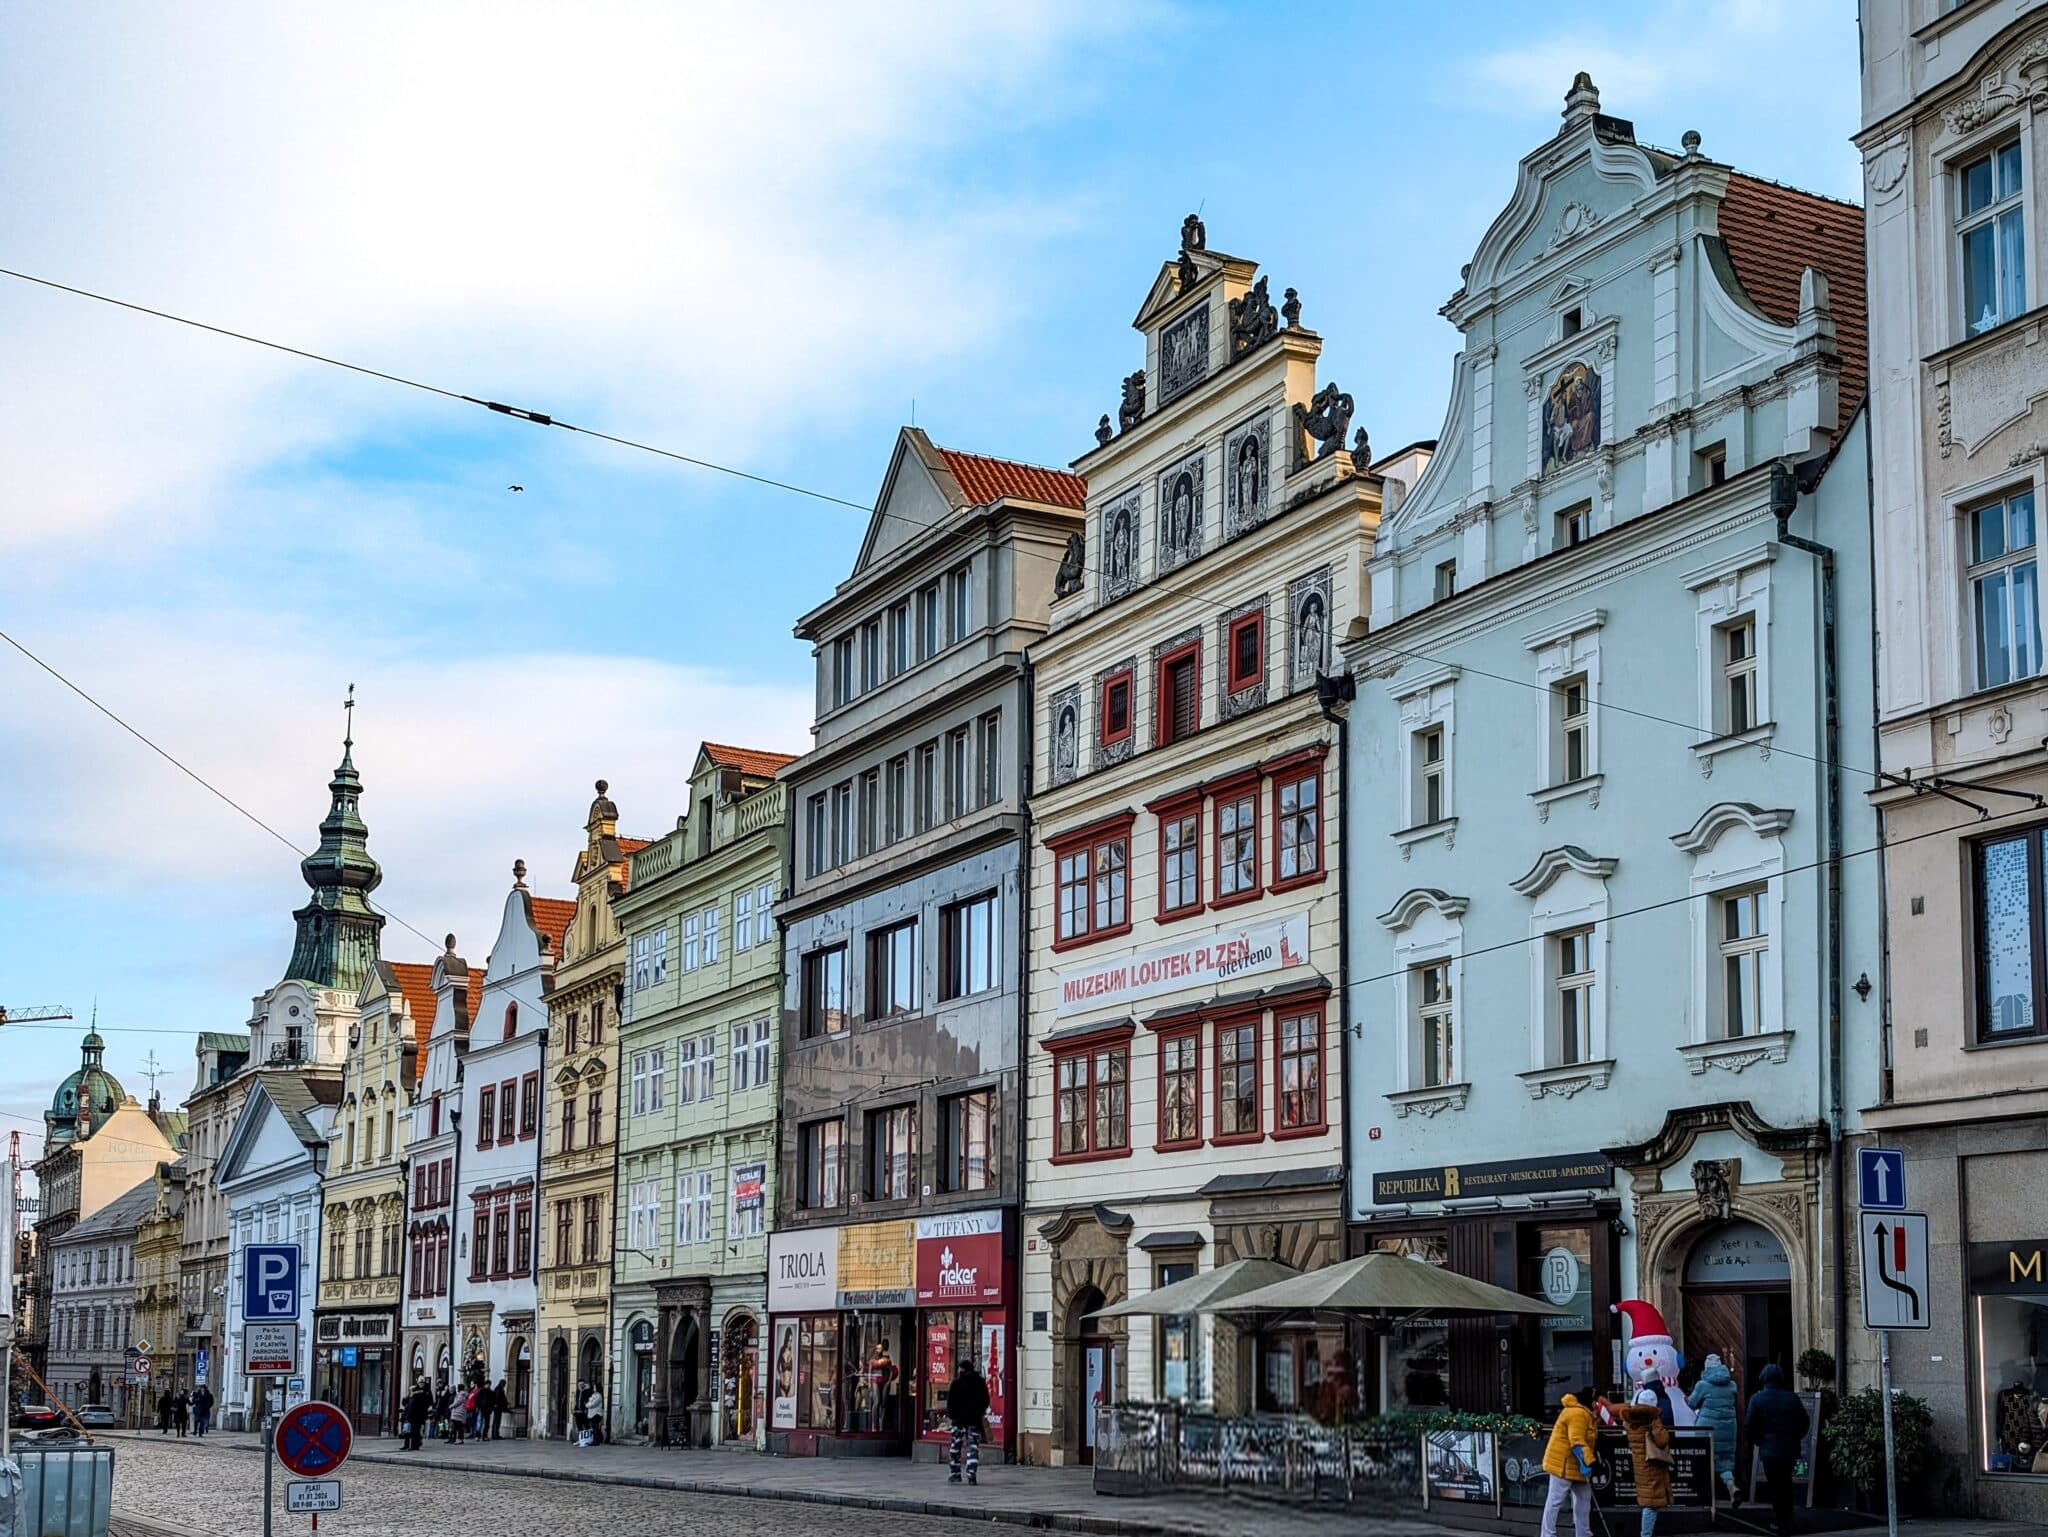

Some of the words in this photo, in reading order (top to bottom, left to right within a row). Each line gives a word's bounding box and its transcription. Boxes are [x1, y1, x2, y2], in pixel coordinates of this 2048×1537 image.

[1063, 967, 1126, 1003] MUZEUM
[1131, 952, 1192, 987] LOUTEK
[1195, 932, 1250, 972] PLZEŇ
[1379, 1176, 1440, 1195] REPUBLIKA
[1443, 1167, 1460, 1197] R
[934, 1218, 983, 1237] TIFFANY
[258, 1254, 290, 1296] P
[779, 1251, 826, 1279] TRIOLA
[939, 1262, 977, 1286] rieker
[1550, 1255, 1571, 1294] R
[932, 1362, 946, 1374] 50%
